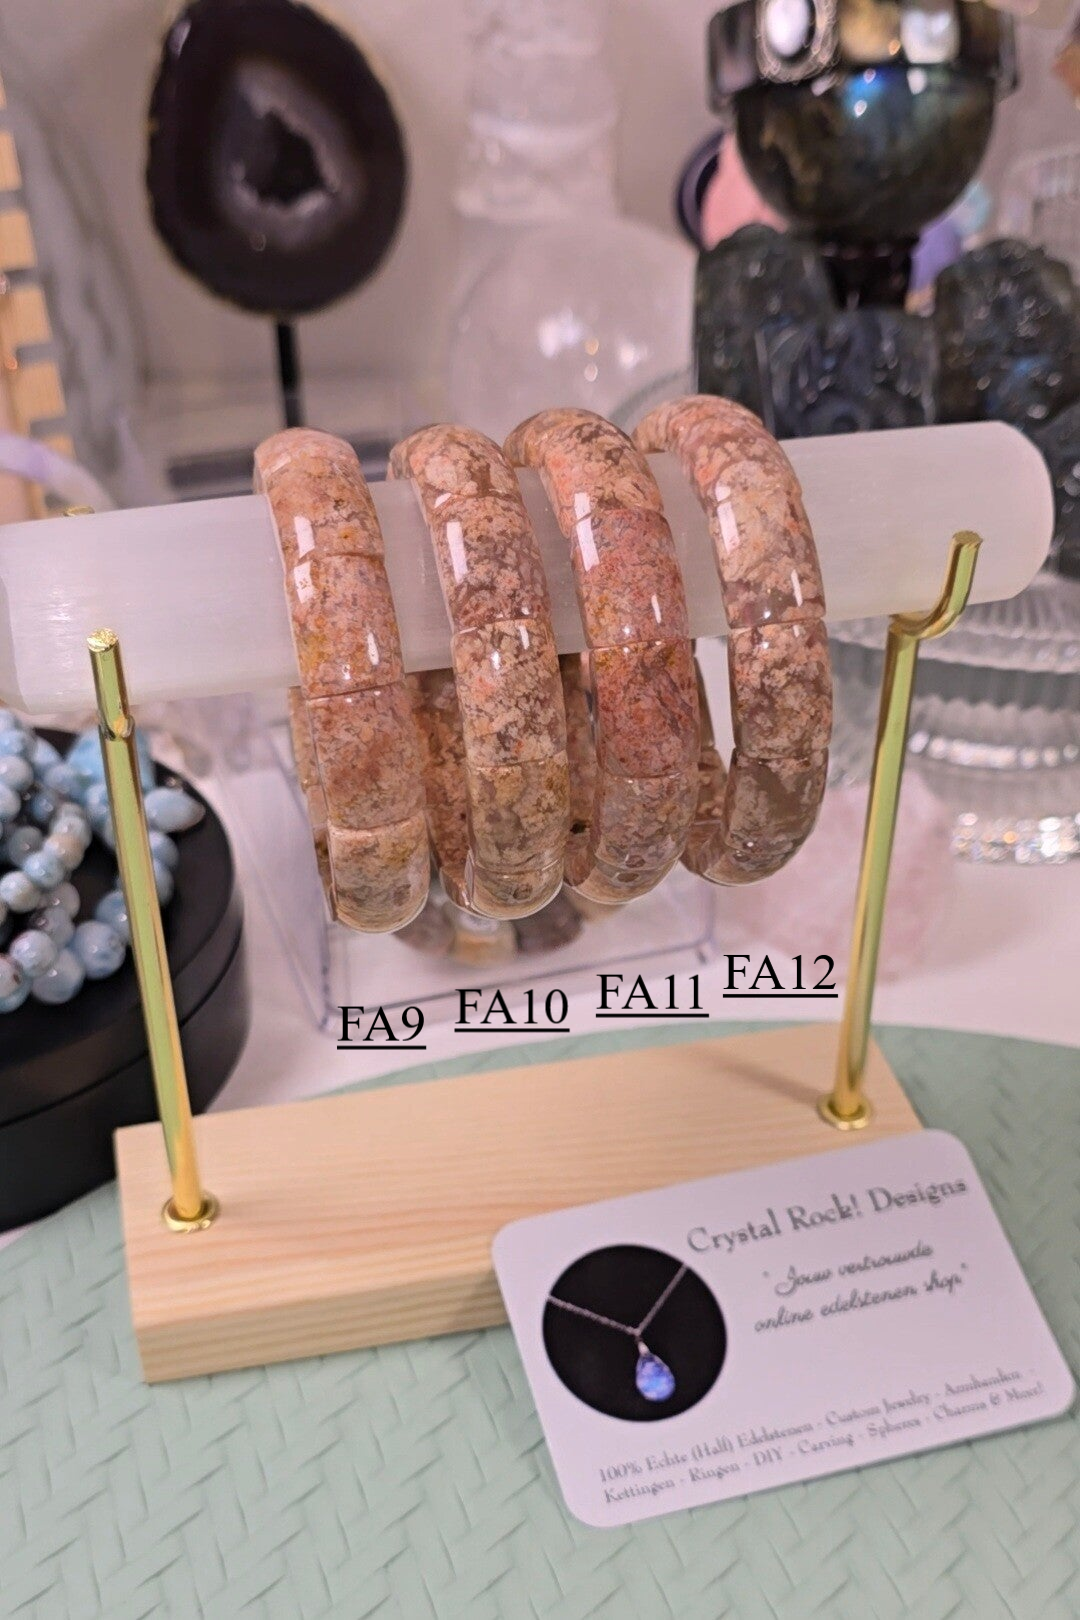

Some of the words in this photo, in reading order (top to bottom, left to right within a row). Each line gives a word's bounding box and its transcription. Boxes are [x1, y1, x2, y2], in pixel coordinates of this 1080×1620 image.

[687, 1208, 782, 1253] Crystal
[786, 1193, 863, 1231] Rock!
[867, 1179, 967, 1212] Designs
[754, 1304, 814, 1332] online
[820, 1286, 918, 1317] edelstenen
[599, 1460, 642, 1482] 100%
[646, 1452, 687, 1470] Echte
[691, 1435, 733, 1462] (Half)
[737, 1423, 813, 1449] Edelstenen
[825, 1406, 880, 1425] Custom
[604, 1479, 675, 1503] Kettingen
[689, 1462, 740, 1482] Ringen
[753, 1447, 783, 1466] DIY
[797, 1434, 854, 1455] Carving
